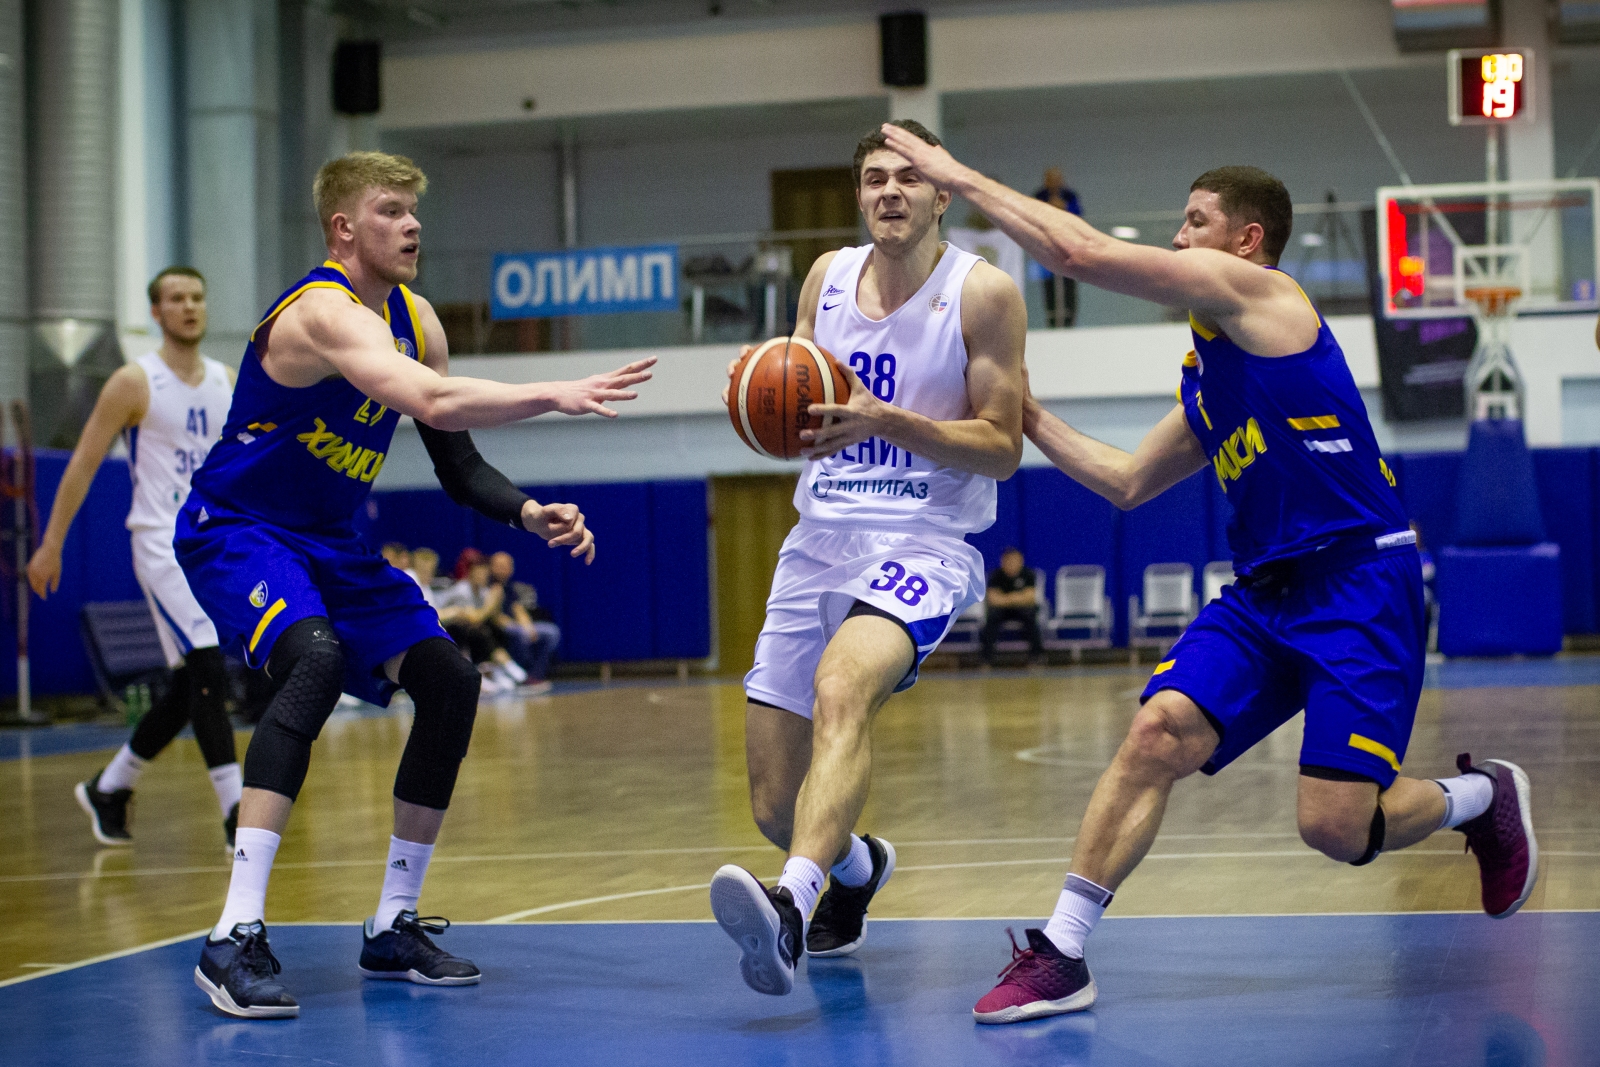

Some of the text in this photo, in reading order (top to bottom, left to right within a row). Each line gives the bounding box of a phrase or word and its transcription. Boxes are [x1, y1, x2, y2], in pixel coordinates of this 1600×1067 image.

[1482, 82, 1515, 118] 19
[496, 254, 674, 308] ОЛИМП
[849, 352, 896, 404] 38
[186, 407, 208, 437] 41
[869, 560, 929, 607] 38
